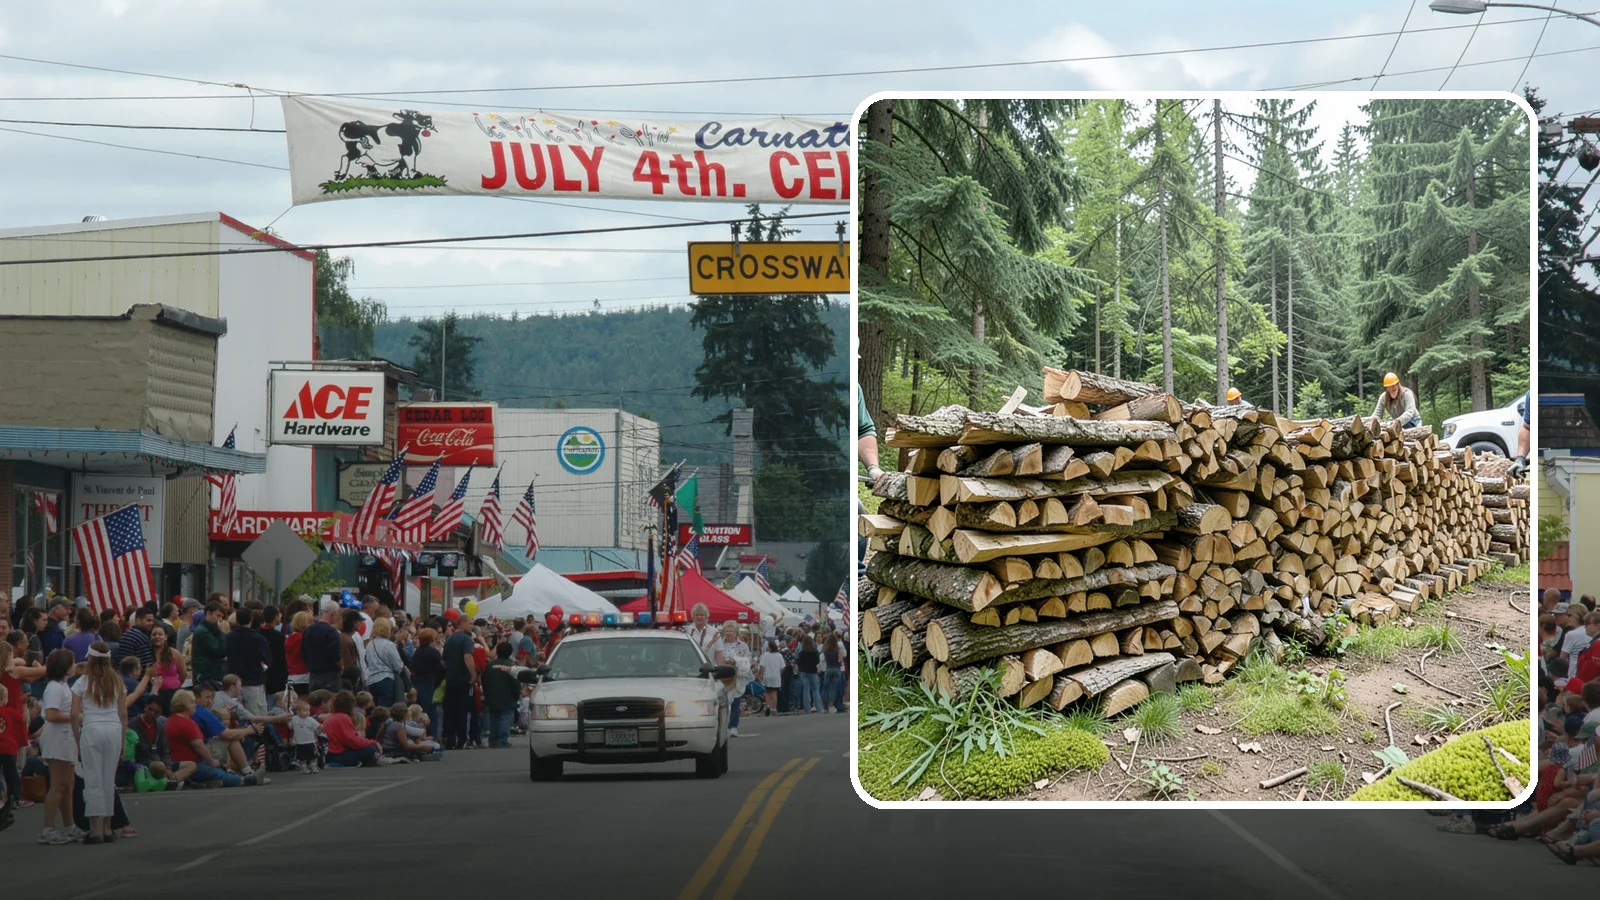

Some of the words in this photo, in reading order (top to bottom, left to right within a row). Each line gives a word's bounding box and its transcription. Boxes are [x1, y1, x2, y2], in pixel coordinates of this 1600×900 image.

[481, 141, 605, 193] JULY
[632, 150, 746, 197] 4th.
[697, 254, 850, 280] CROSSWA
[283, 380, 373, 420] ACE
[405, 409, 452, 422] CEDAR
[284, 421, 370, 436] Hardware
[95, 485, 124, 495] Vincent
[126, 486, 136, 495] de
[138, 486, 155, 495] Paul
[688, 526, 741, 535] CRNATION
[699, 535, 730, 543] GLASS
